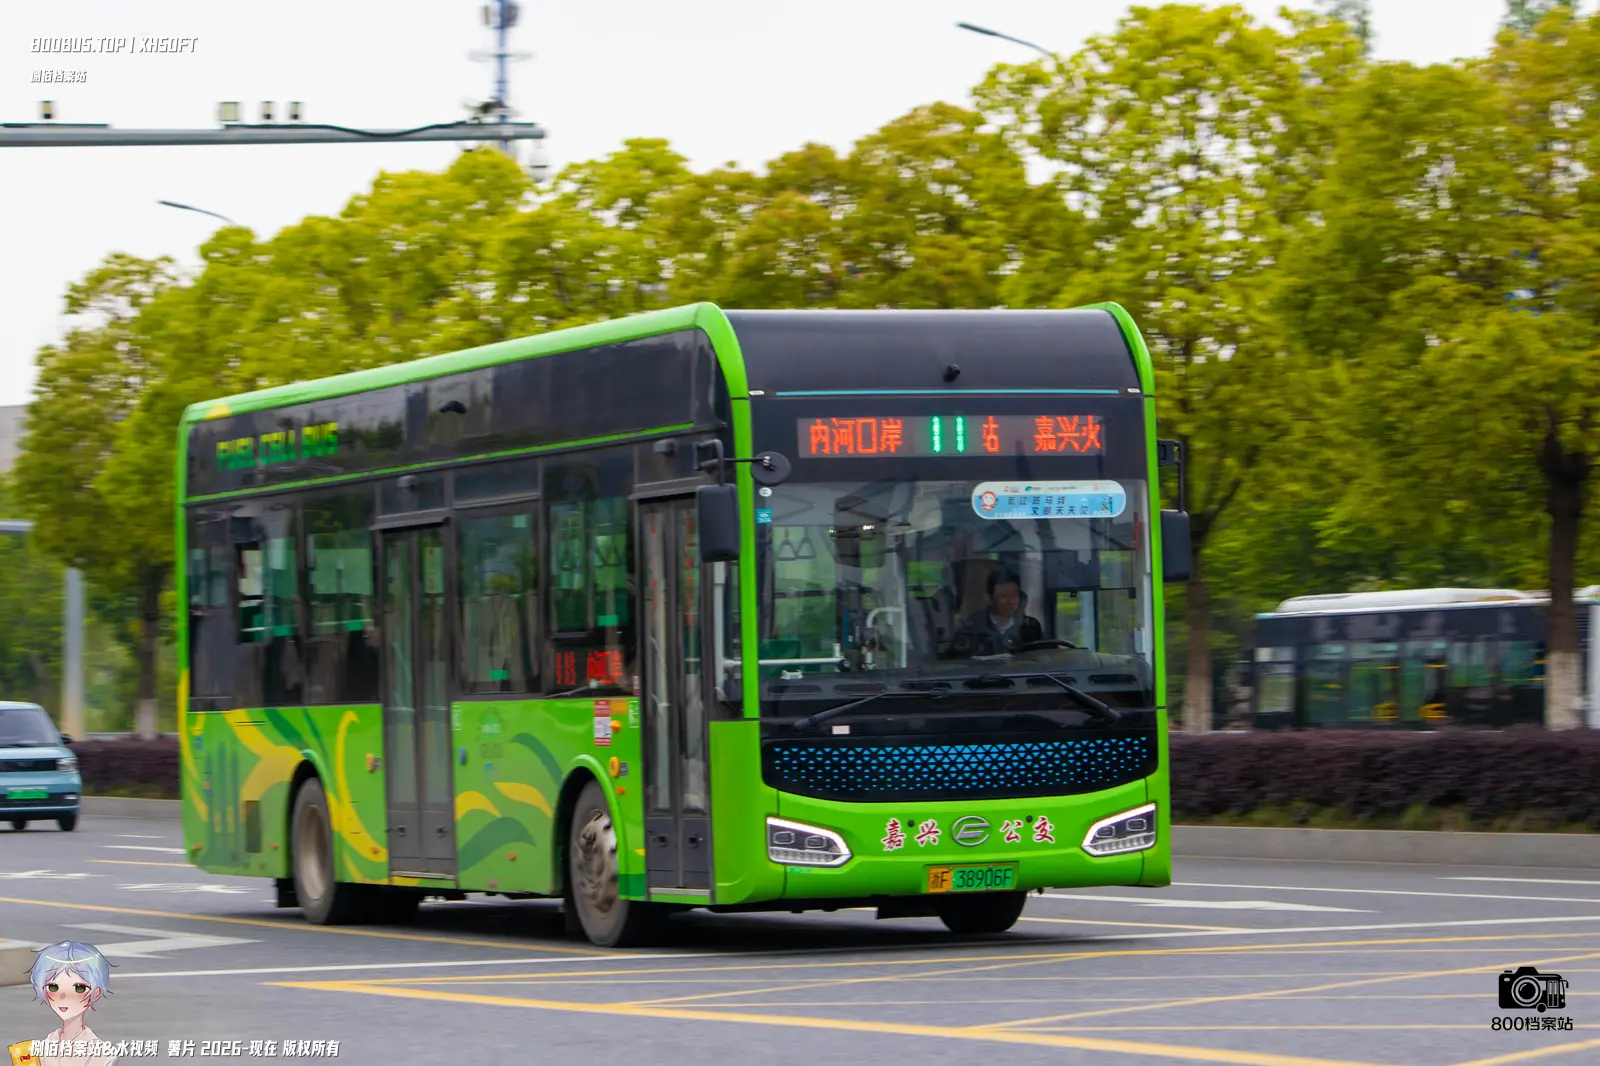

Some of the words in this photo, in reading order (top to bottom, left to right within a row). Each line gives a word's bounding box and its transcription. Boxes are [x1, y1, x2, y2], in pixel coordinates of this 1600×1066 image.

[810, 418, 903, 455] 内河口岸
[932, 416, 967, 453] 11
[1033, 415, 1102, 453] 嘉兴火
[882, 818, 943, 851] 嘉兴
[999, 815, 1056, 844] 公交
